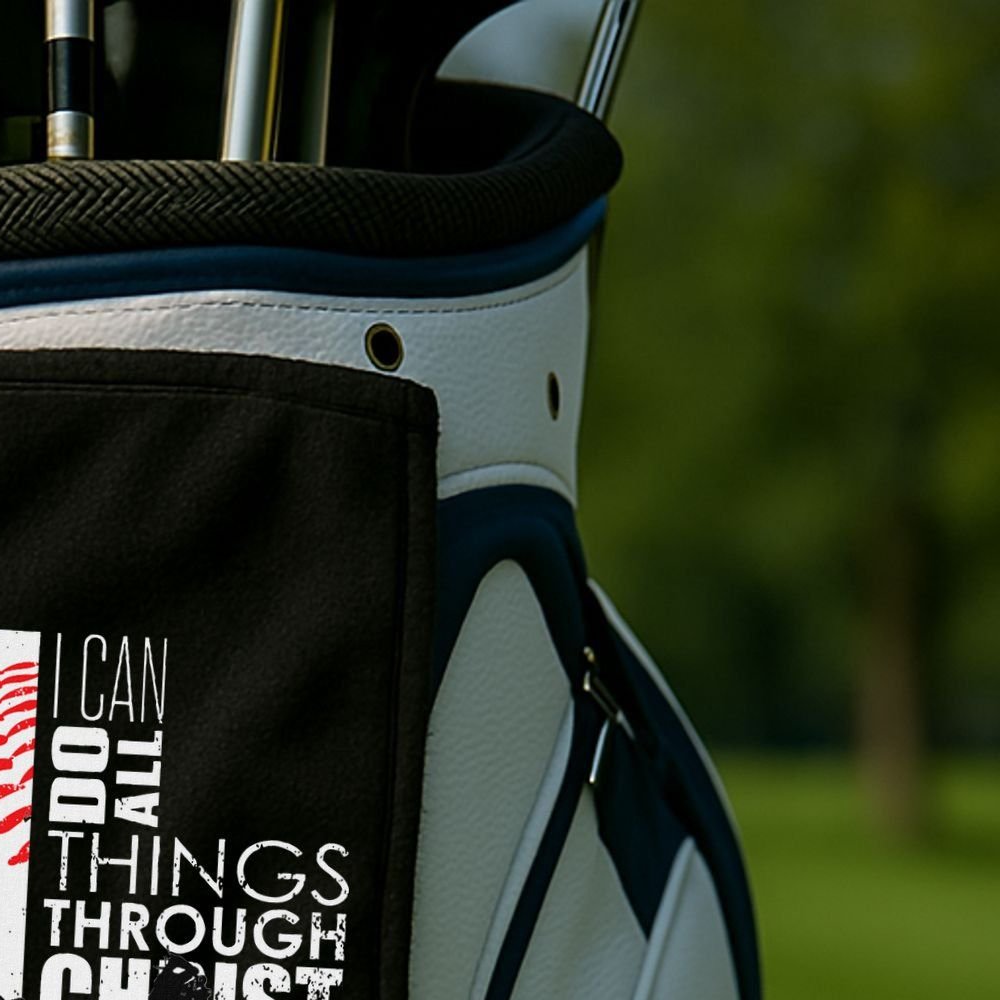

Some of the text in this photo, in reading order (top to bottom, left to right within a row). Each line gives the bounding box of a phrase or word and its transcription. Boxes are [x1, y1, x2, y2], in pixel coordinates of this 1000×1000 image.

[53, 632, 168, 724] I CAN
[48, 725, 110, 825] DO
[114, 730, 163, 828] ALL
[47, 830, 350, 906] THINGS
[43, 898, 347, 961] THROUGH
